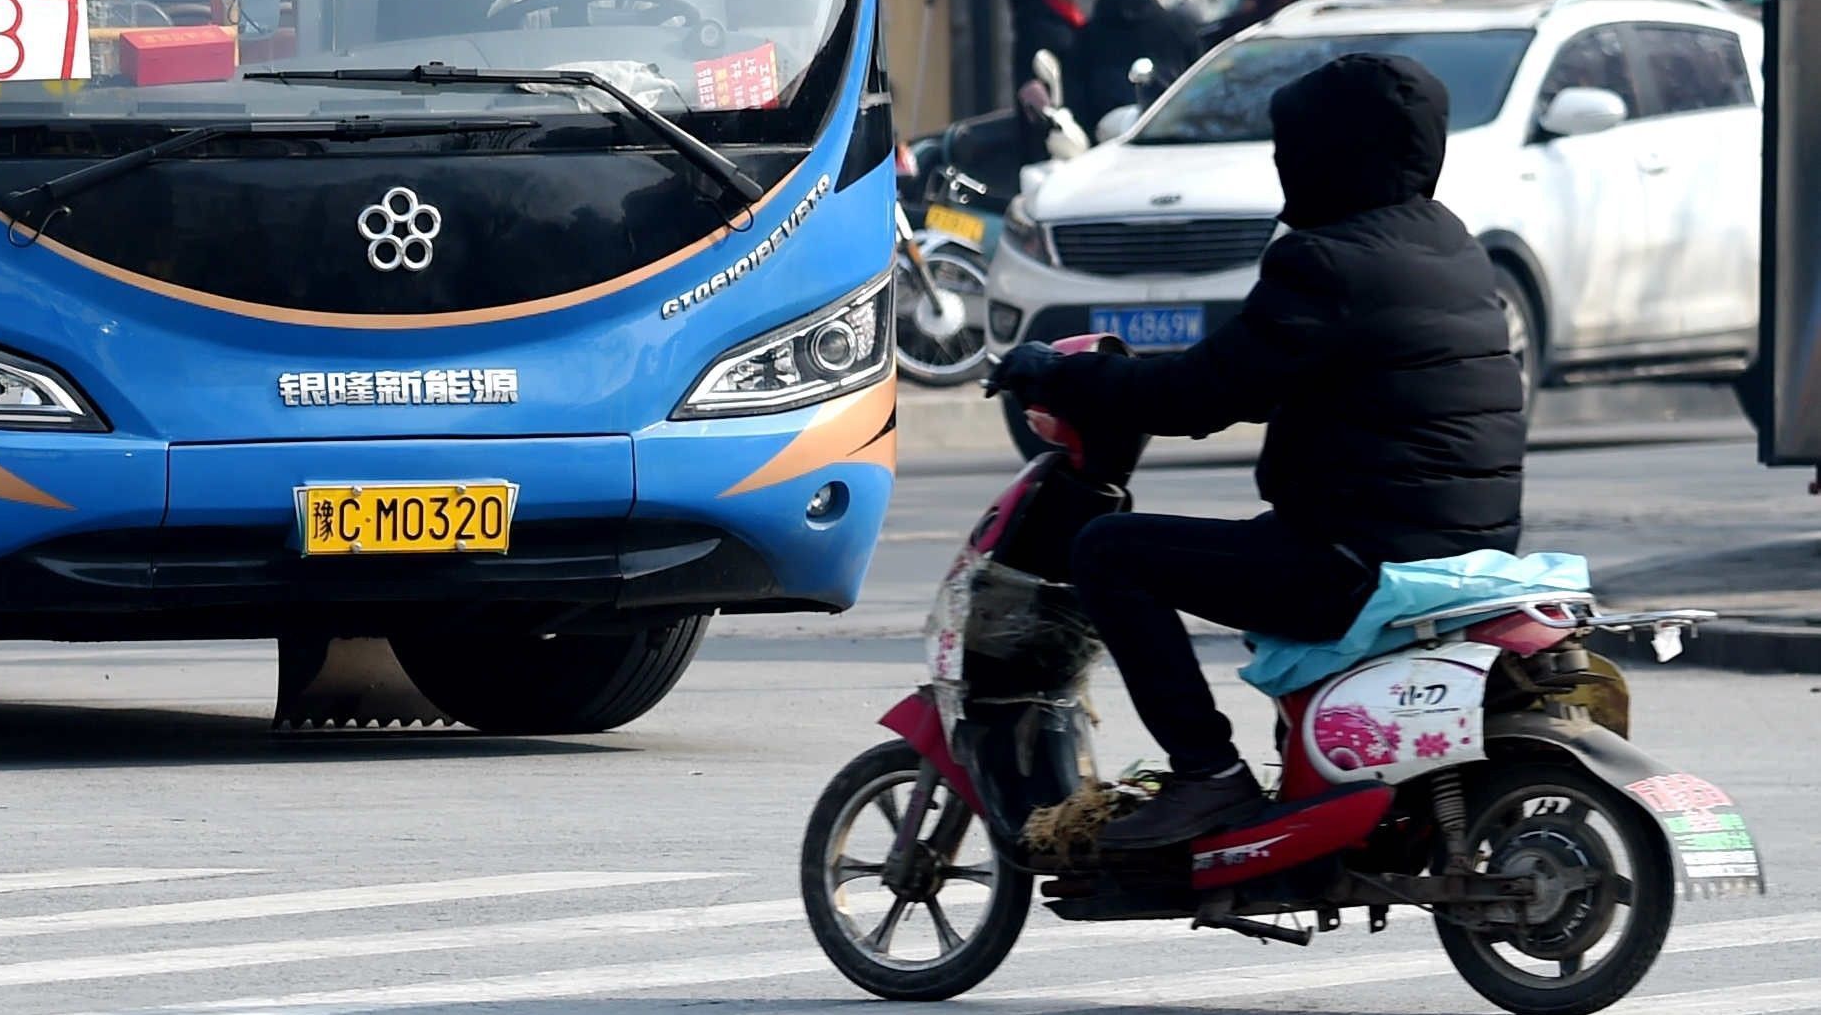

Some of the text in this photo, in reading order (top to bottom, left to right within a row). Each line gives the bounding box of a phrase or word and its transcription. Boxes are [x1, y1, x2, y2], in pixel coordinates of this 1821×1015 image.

[278, 369, 520, 407] 银隆新能源
